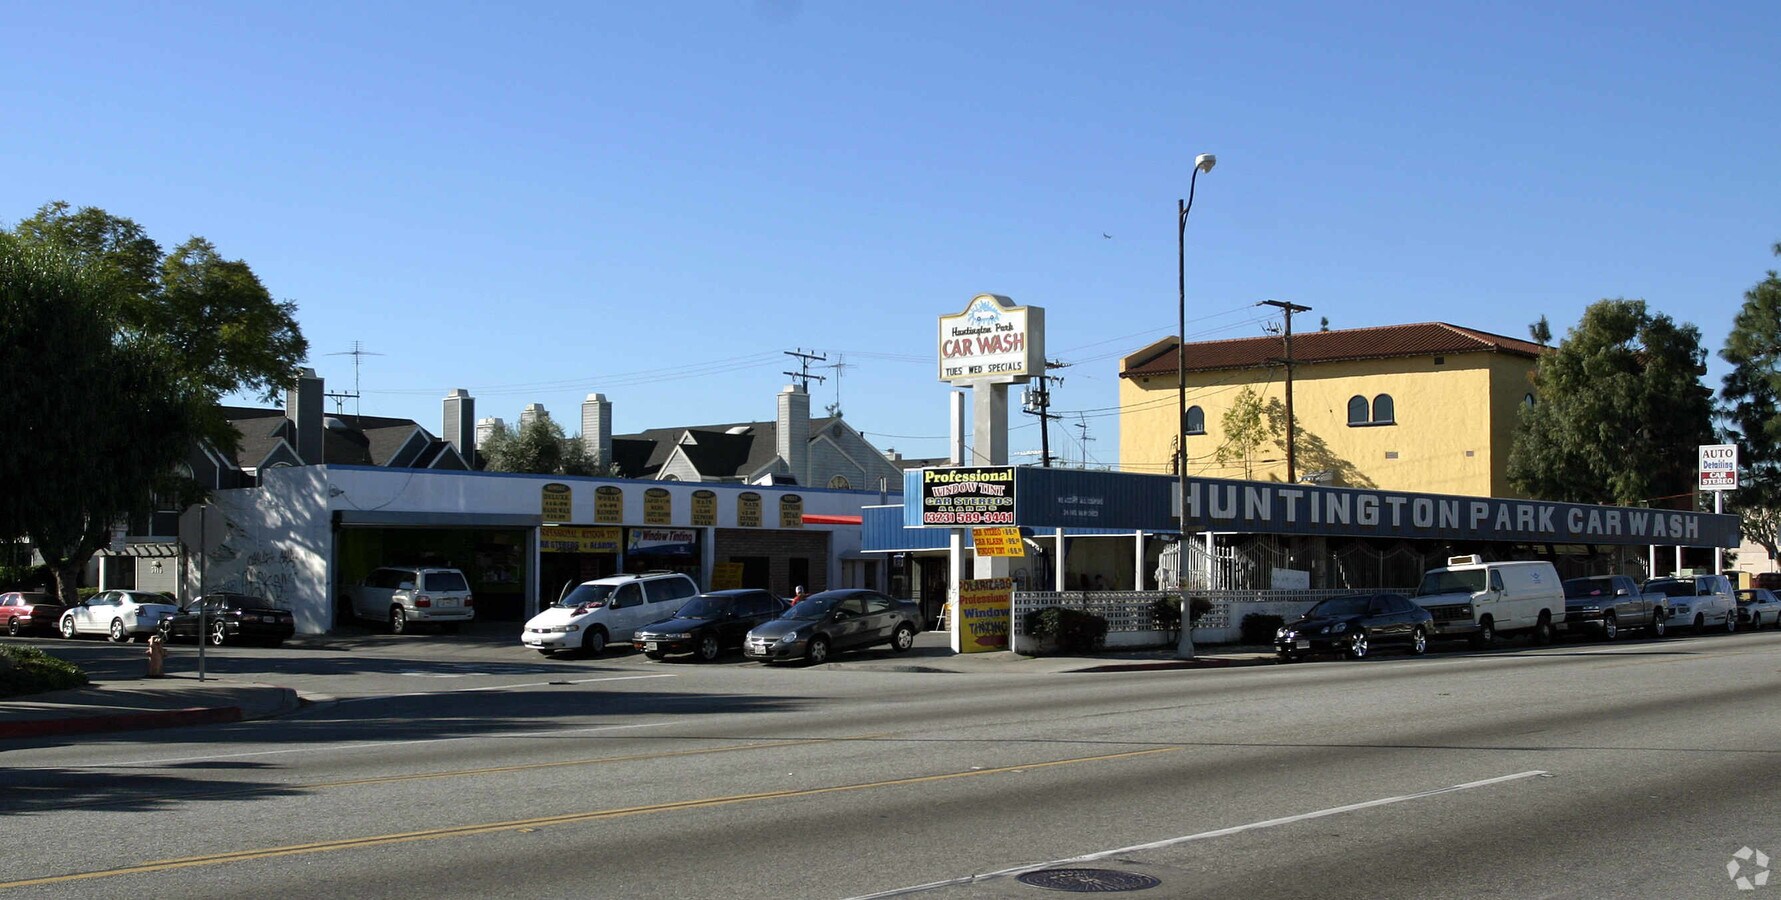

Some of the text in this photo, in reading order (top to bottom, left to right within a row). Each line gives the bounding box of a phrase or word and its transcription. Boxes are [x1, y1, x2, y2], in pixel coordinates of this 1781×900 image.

[952, 322, 1014, 337] Huntington Park
[942, 332, 1025, 358] CAR WASH
[946, 362, 1022, 376] TUES WED SPECIALS
[1703, 449, 1733, 458] AUTO
[1704, 460, 1733, 470] Detailing
[925, 469, 1013, 483] Professional
[932, 482, 1005, 497] WINDOW TINT
[925, 497, 1013, 506] CAR STEREOS
[924, 511, 1013, 523] (323) 589-3441
[1171, 482, 1698, 538] HUNTINGTON PARK CAR WASH
[643, 530, 692, 544] Window Tinting
[964, 607, 1010, 618] Window
